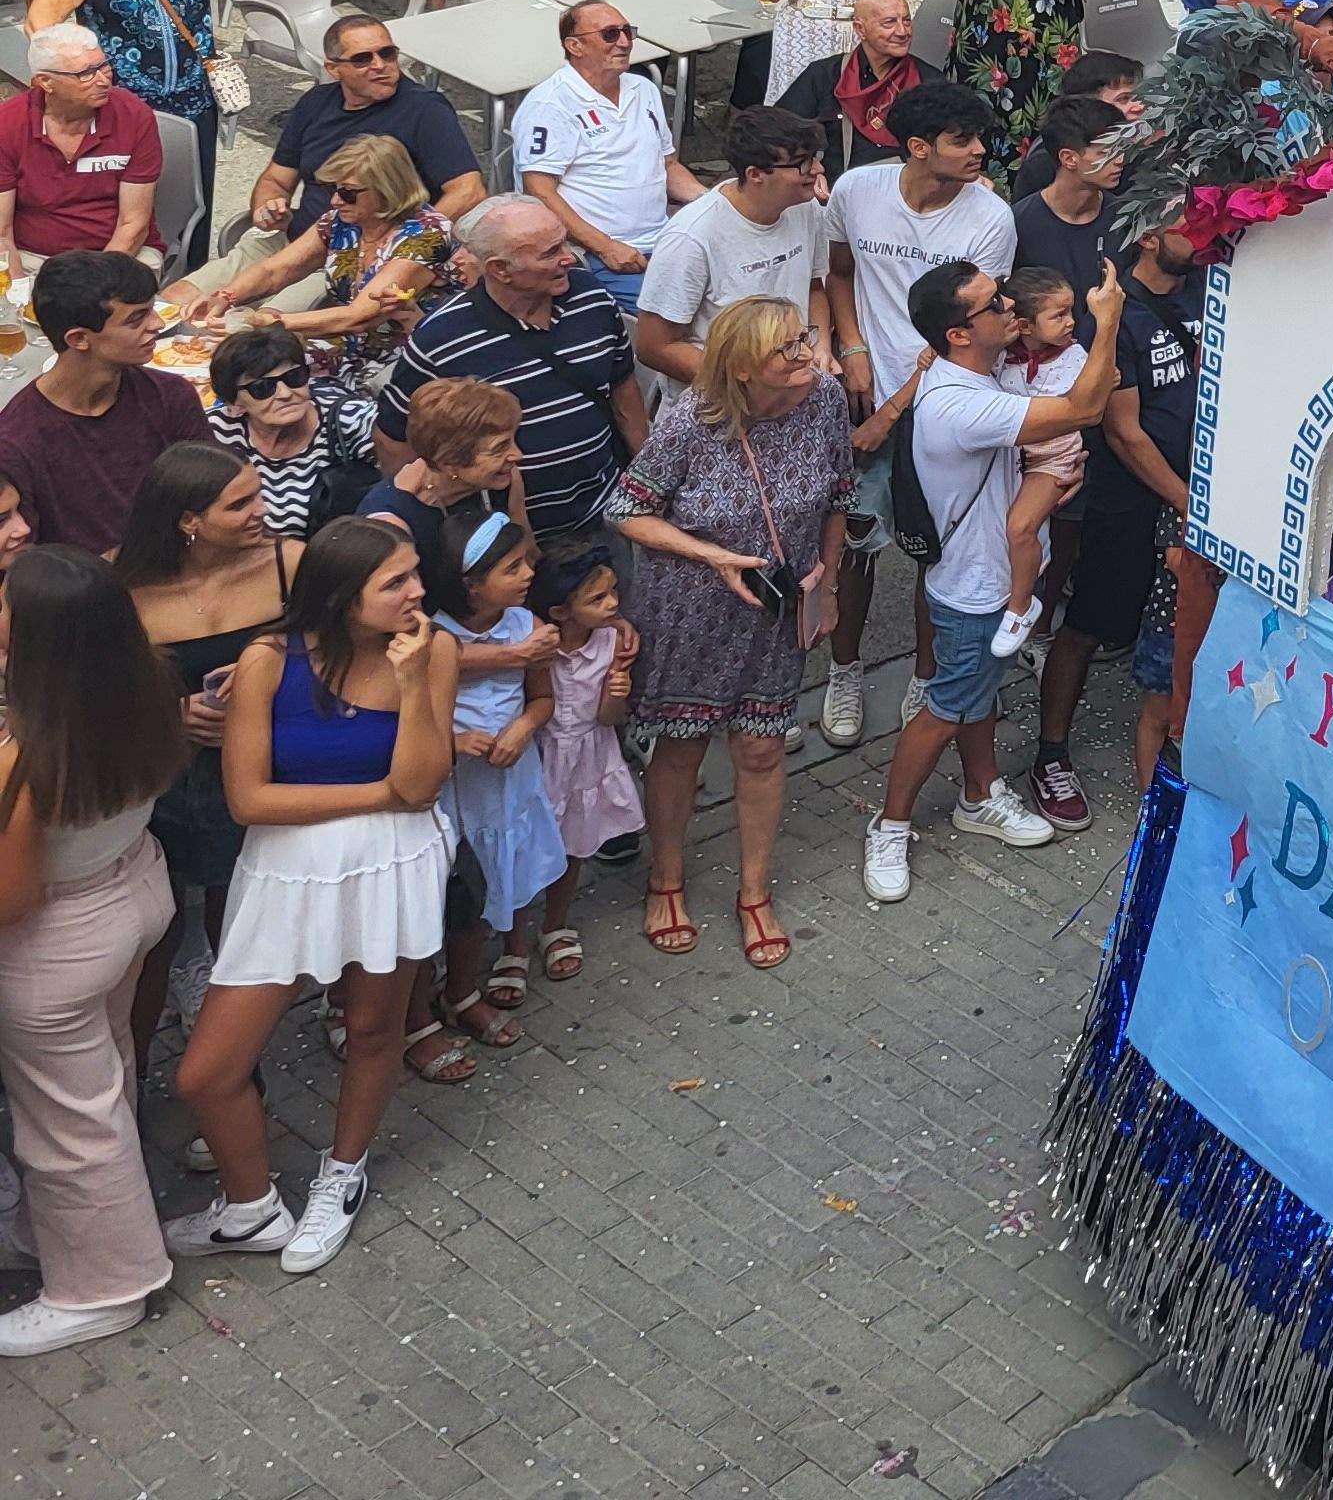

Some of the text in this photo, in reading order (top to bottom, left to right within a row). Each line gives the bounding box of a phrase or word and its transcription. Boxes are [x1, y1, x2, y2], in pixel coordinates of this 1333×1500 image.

[529, 126, 548, 155] 3
[857, 238, 894, 257] CALVIN
[895, 245, 928, 264] KLEIN
